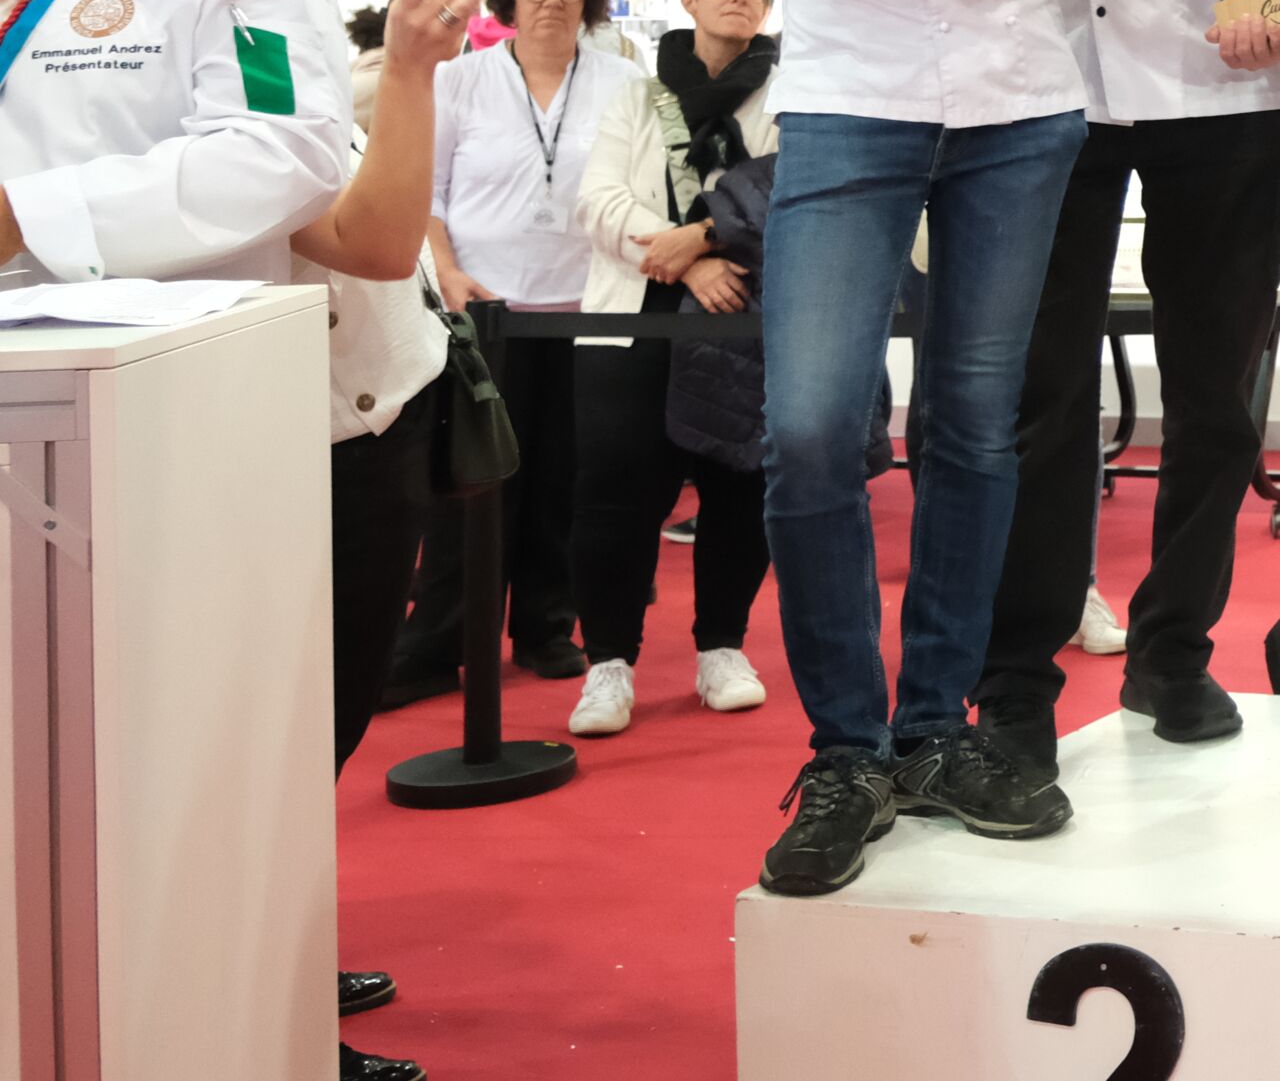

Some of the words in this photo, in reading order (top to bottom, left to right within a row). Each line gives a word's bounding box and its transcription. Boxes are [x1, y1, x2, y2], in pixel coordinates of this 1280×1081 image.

[31, 45, 102, 60] Emmanuel
[109, 45, 162, 54] Andrez
[45, 60, 144, 73] Présentateur
